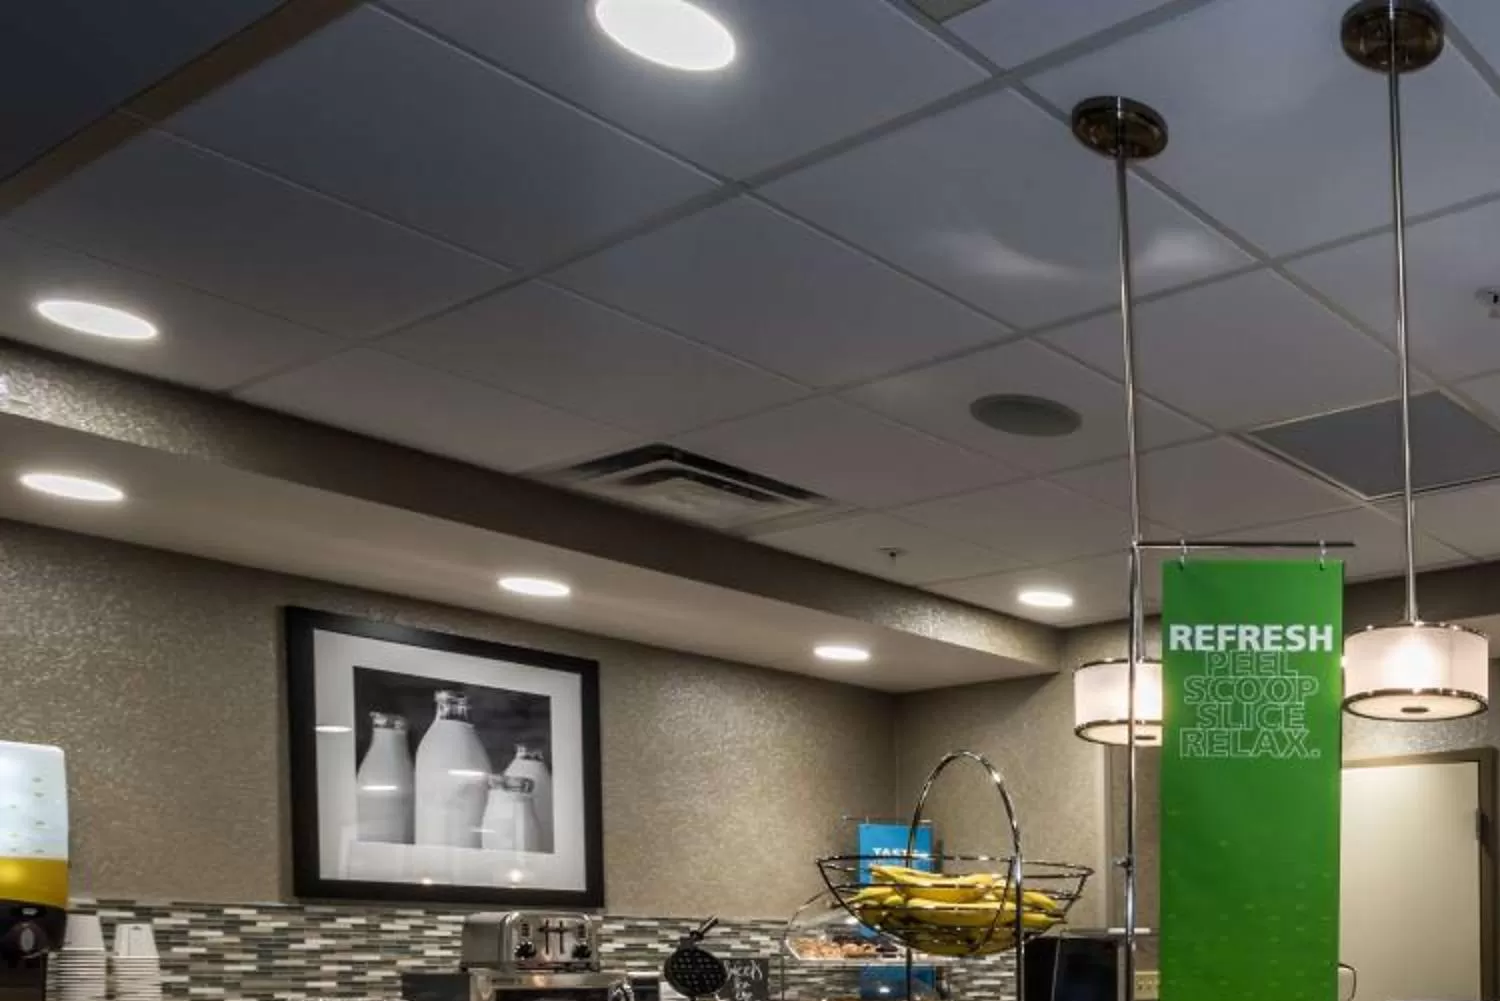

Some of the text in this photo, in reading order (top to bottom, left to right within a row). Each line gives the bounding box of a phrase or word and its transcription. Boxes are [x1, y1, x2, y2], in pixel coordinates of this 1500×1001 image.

[1169, 623, 1334, 652] REFRESH
[1205, 649, 1299, 677] PEEL
[1183, 675, 1320, 704] SCOOP
[1197, 702, 1305, 731] SLICE
[1179, 727, 1321, 759] RELAX.
